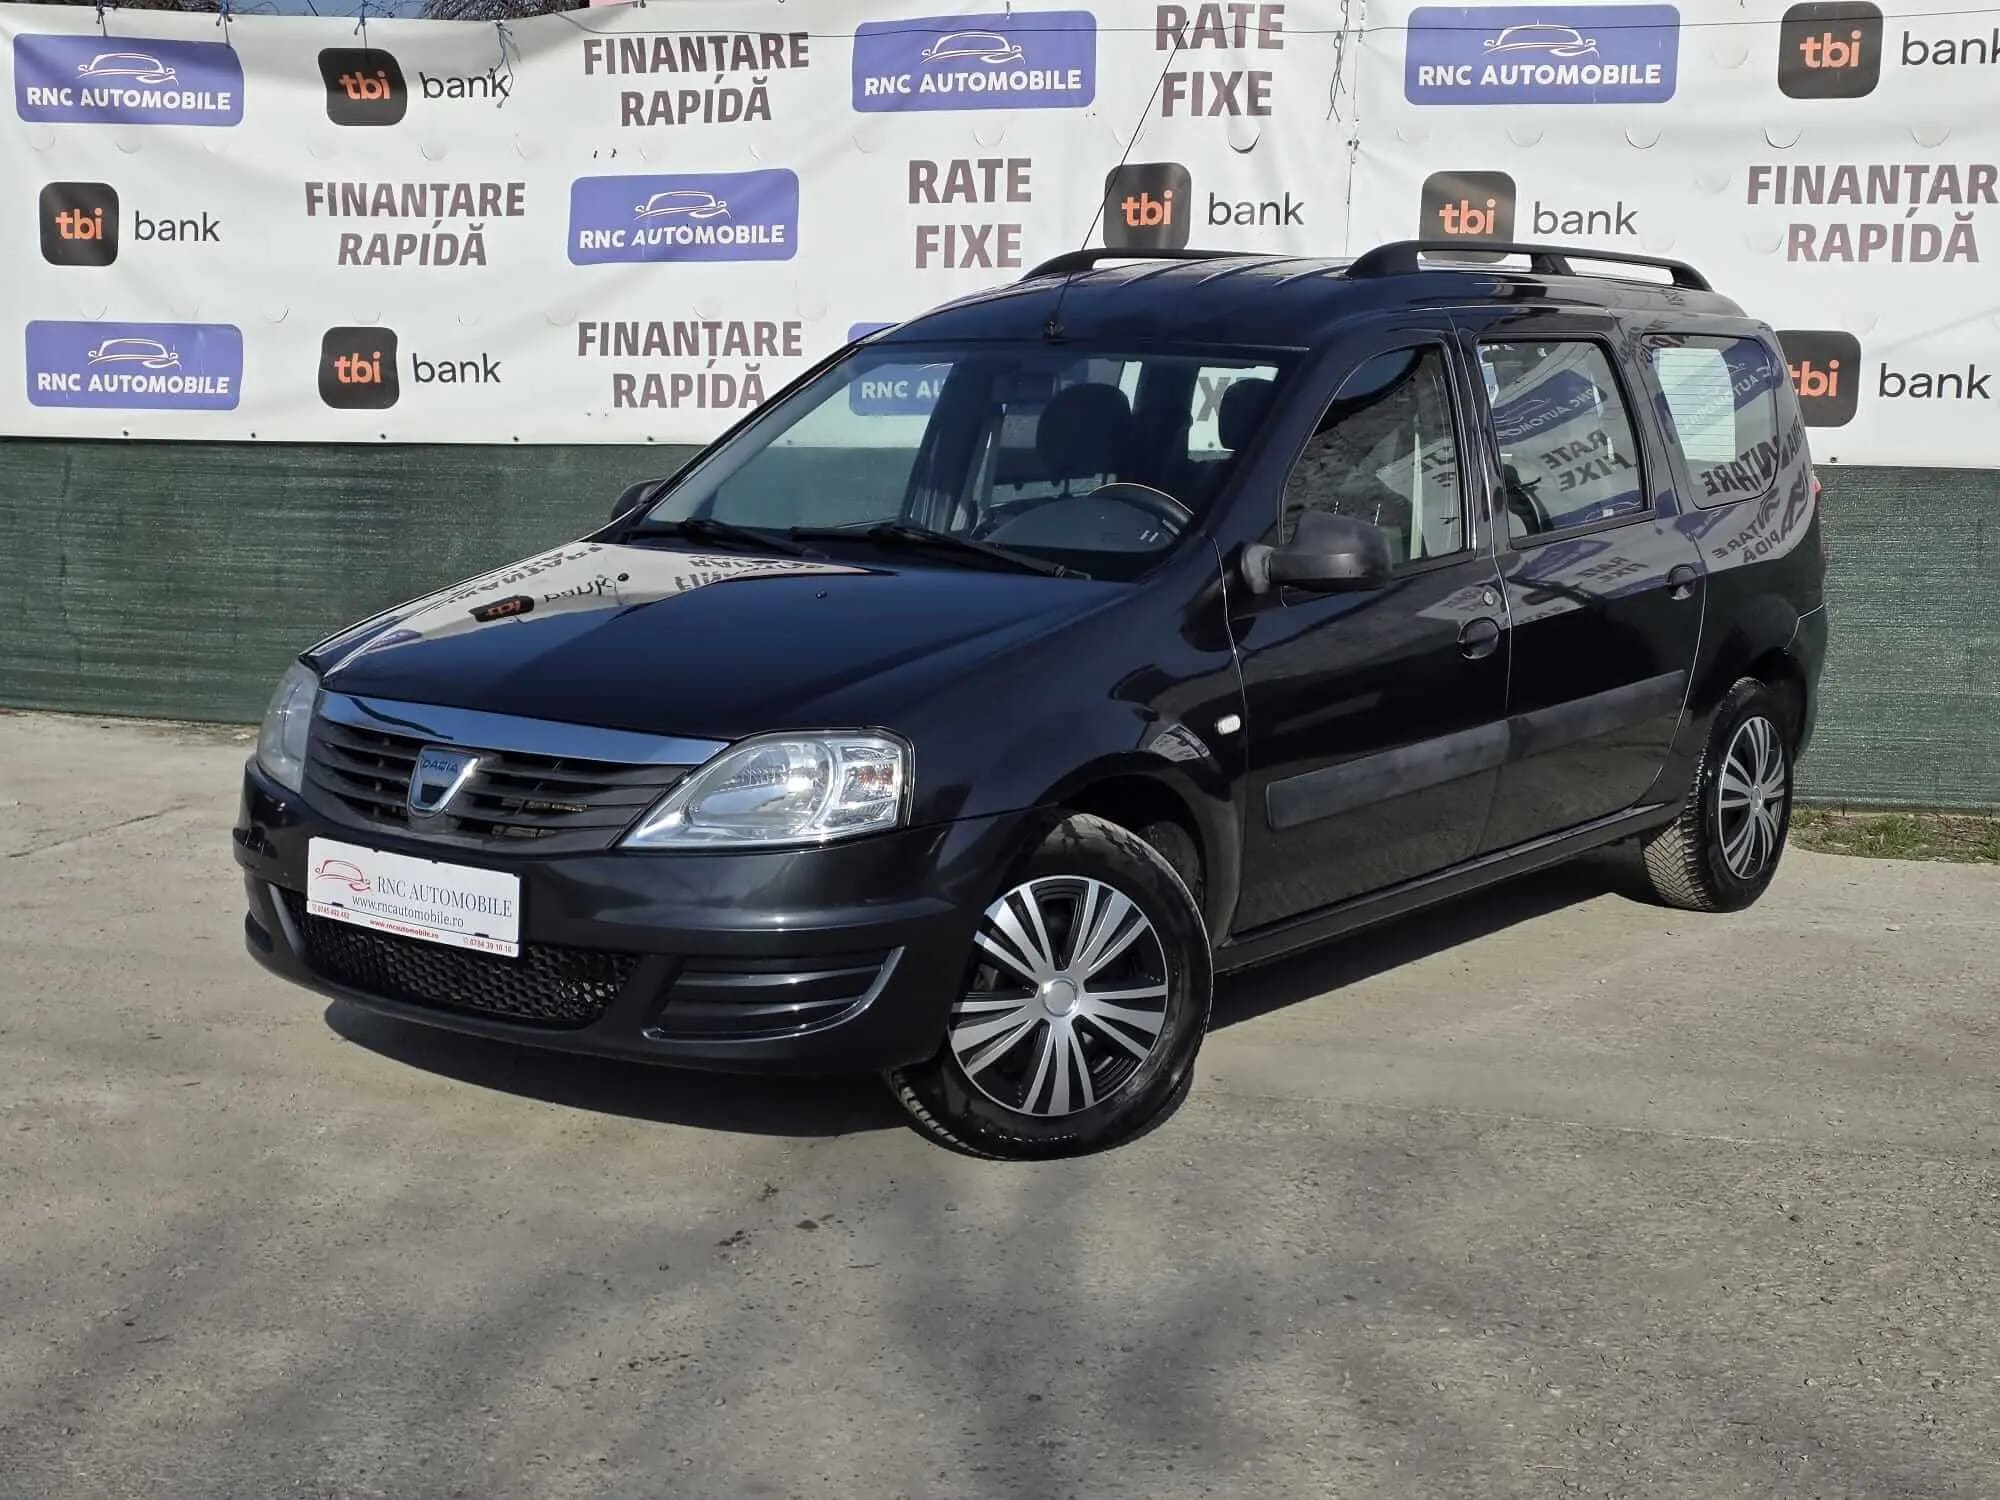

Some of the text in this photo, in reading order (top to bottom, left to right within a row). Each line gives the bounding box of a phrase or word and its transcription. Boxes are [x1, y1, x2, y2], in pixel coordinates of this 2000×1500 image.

[1156, 4, 1284, 50] RATE
[1800, 31, 1862, 68] tbi
[338, 71, 510, 101] tbi bank
[864, 70, 1081, 96] RNC AUTOMOBILE
[1418, 64, 1661, 86] RNC AUTOMOBILE
[27, 88, 231, 111] RNC AUTOMOBILE
[621, 76, 773, 127] RAPIDĂ
[1161, 71, 1273, 118] FIXE
[909, 158, 1031, 203] RATE
[56, 208, 221, 242] tbi bank
[1121, 190, 1305, 226] tbi bank
[1439, 199, 1637, 236] tbi bank
[338, 225, 487, 267] RAPIDĂ
[579, 224, 785, 248] RNC AUTOMOBILE
[914, 225, 1022, 269] FIXE
[1787, 212, 1979, 263] RAPIDĂ
[38, 373, 229, 395] RNC AUTOMOBILE
[334, 351, 501, 384] tbi bank
[1879, 363, 1992, 400] bank
[613, 366, 766, 410] RAPIDĂ
[862, 379, 908, 401] RNC
[352, 895, 465, 929] www.rncautomobile.ro
[378, 876, 512, 918] RNC AUTOMOBILE
